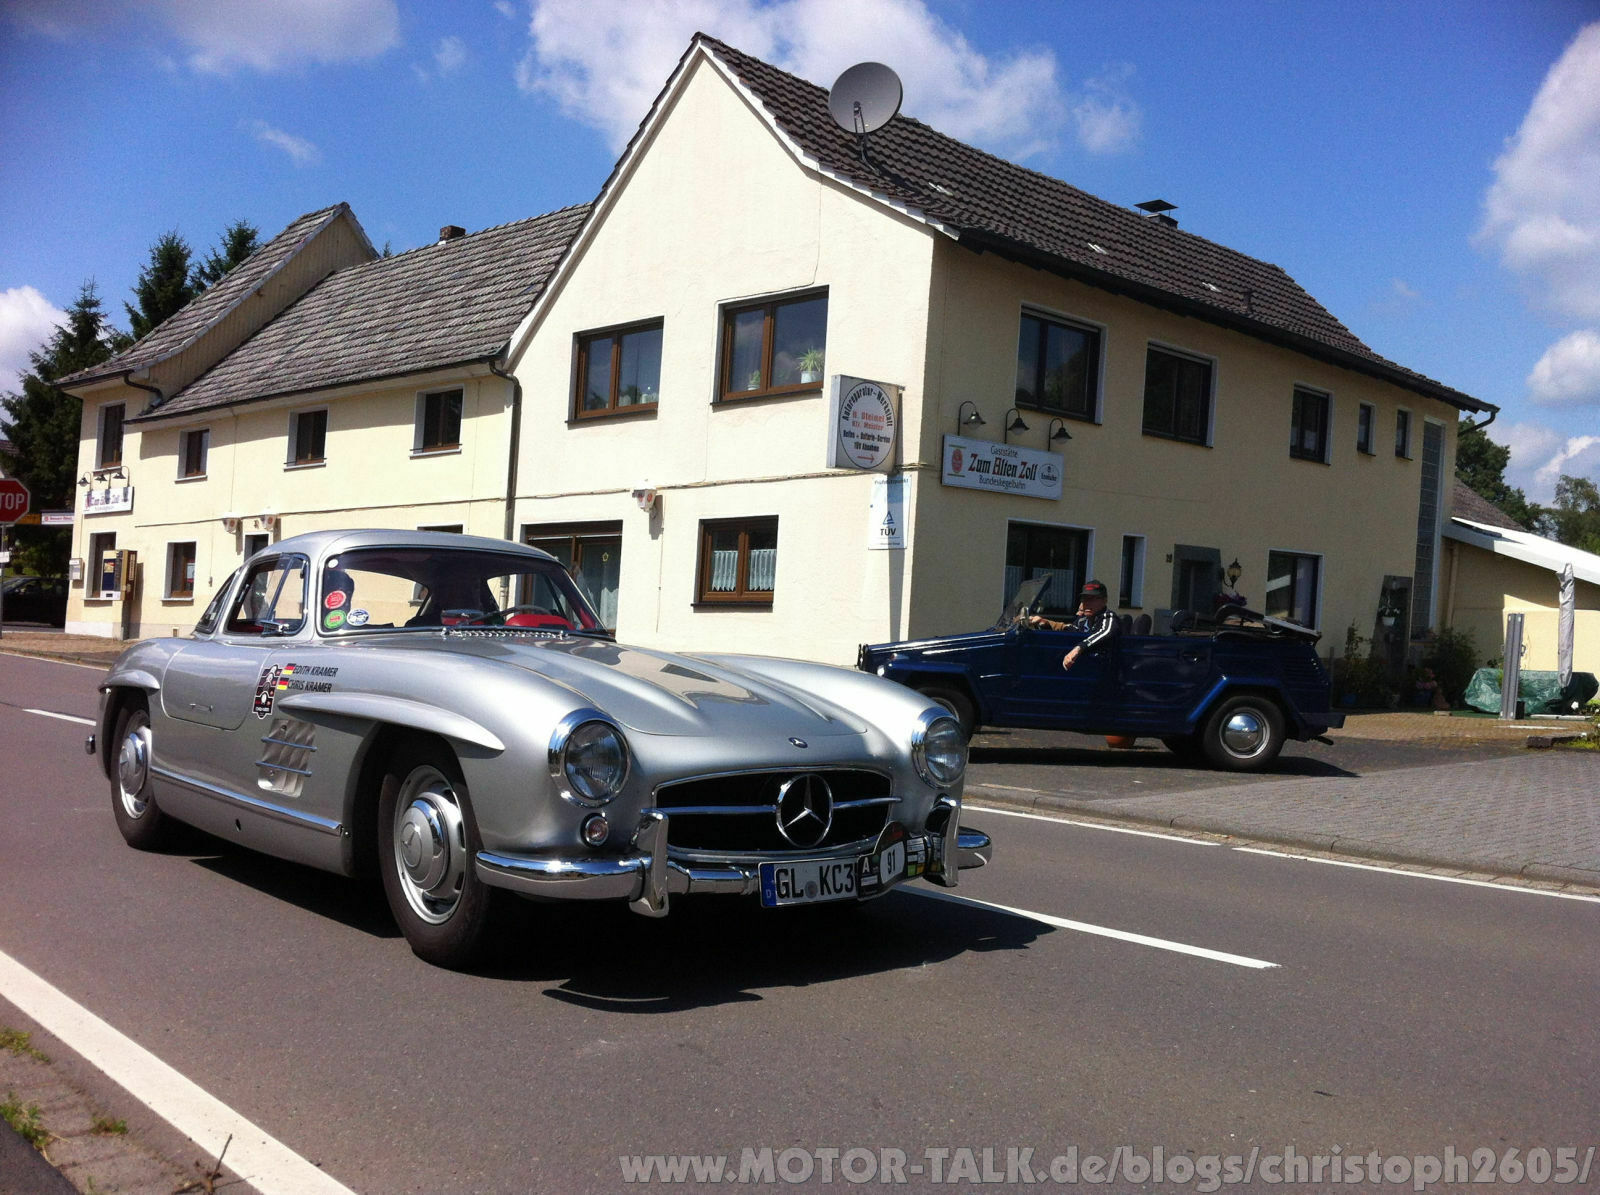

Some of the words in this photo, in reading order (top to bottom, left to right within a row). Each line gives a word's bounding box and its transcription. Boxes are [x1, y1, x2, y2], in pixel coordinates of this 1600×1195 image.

[968, 453, 990, 474] Zum
[992, 457, 1018, 477] Alten
[1018, 461, 1038, 481] Zoll
[0, 492, 25, 510] TOP
[880, 526, 896, 536] TÜV
[293, 664, 311, 675] EDITH
[310, 666, 339, 678] KRAMER
[288, 679, 306, 690] CHRIS
[305, 680, 333, 693] KRAMER
[887, 848, 896, 875] 91
[776, 867, 804, 899] GL
